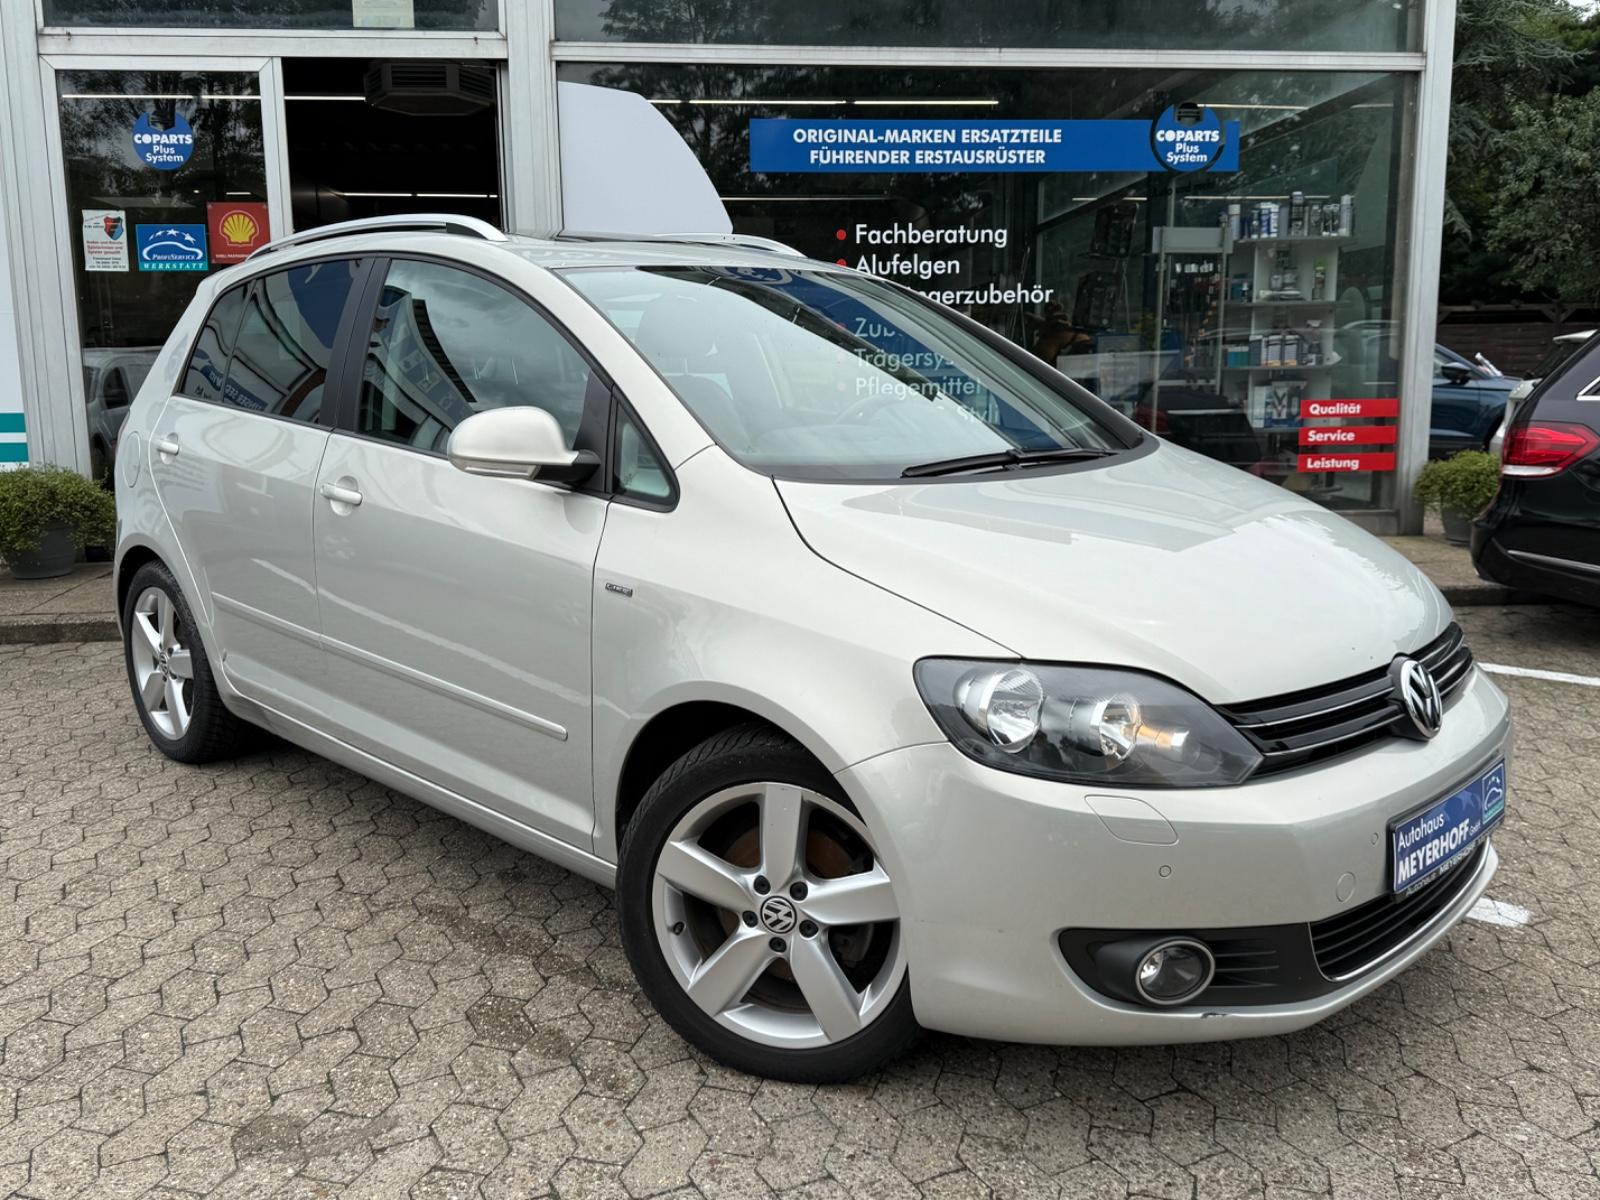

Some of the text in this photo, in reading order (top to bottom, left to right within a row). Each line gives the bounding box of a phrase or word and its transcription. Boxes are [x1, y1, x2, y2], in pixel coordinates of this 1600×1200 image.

[133, 133, 193, 144] COPARTS
[793, 128, 1062, 143] ORIGINAL-MARKEN ERSATZTEILE
[1156, 129, 1220, 142] COPARTS
[153, 145, 175, 154] Plus
[810, 145, 1046, 164] FÜHRENDER ERSTAUSRÜSTER
[1175, 142, 1200, 153] Plus
[146, 152, 184, 164] System
[1166, 151, 1208, 165] System
[855, 222, 1008, 248] Fachberatung
[855, 253, 960, 279] Alufelgen
[856, 376, 980, 400] Pflegemittel
[1309, 402, 1361, 415] Qualität
[1308, 429, 1355, 442] Service
[1307, 457, 1360, 471] Leistung
[1397, 813, 1445, 852] Autohaus
[1397, 818, 1470, 885] MEYERHOFF
